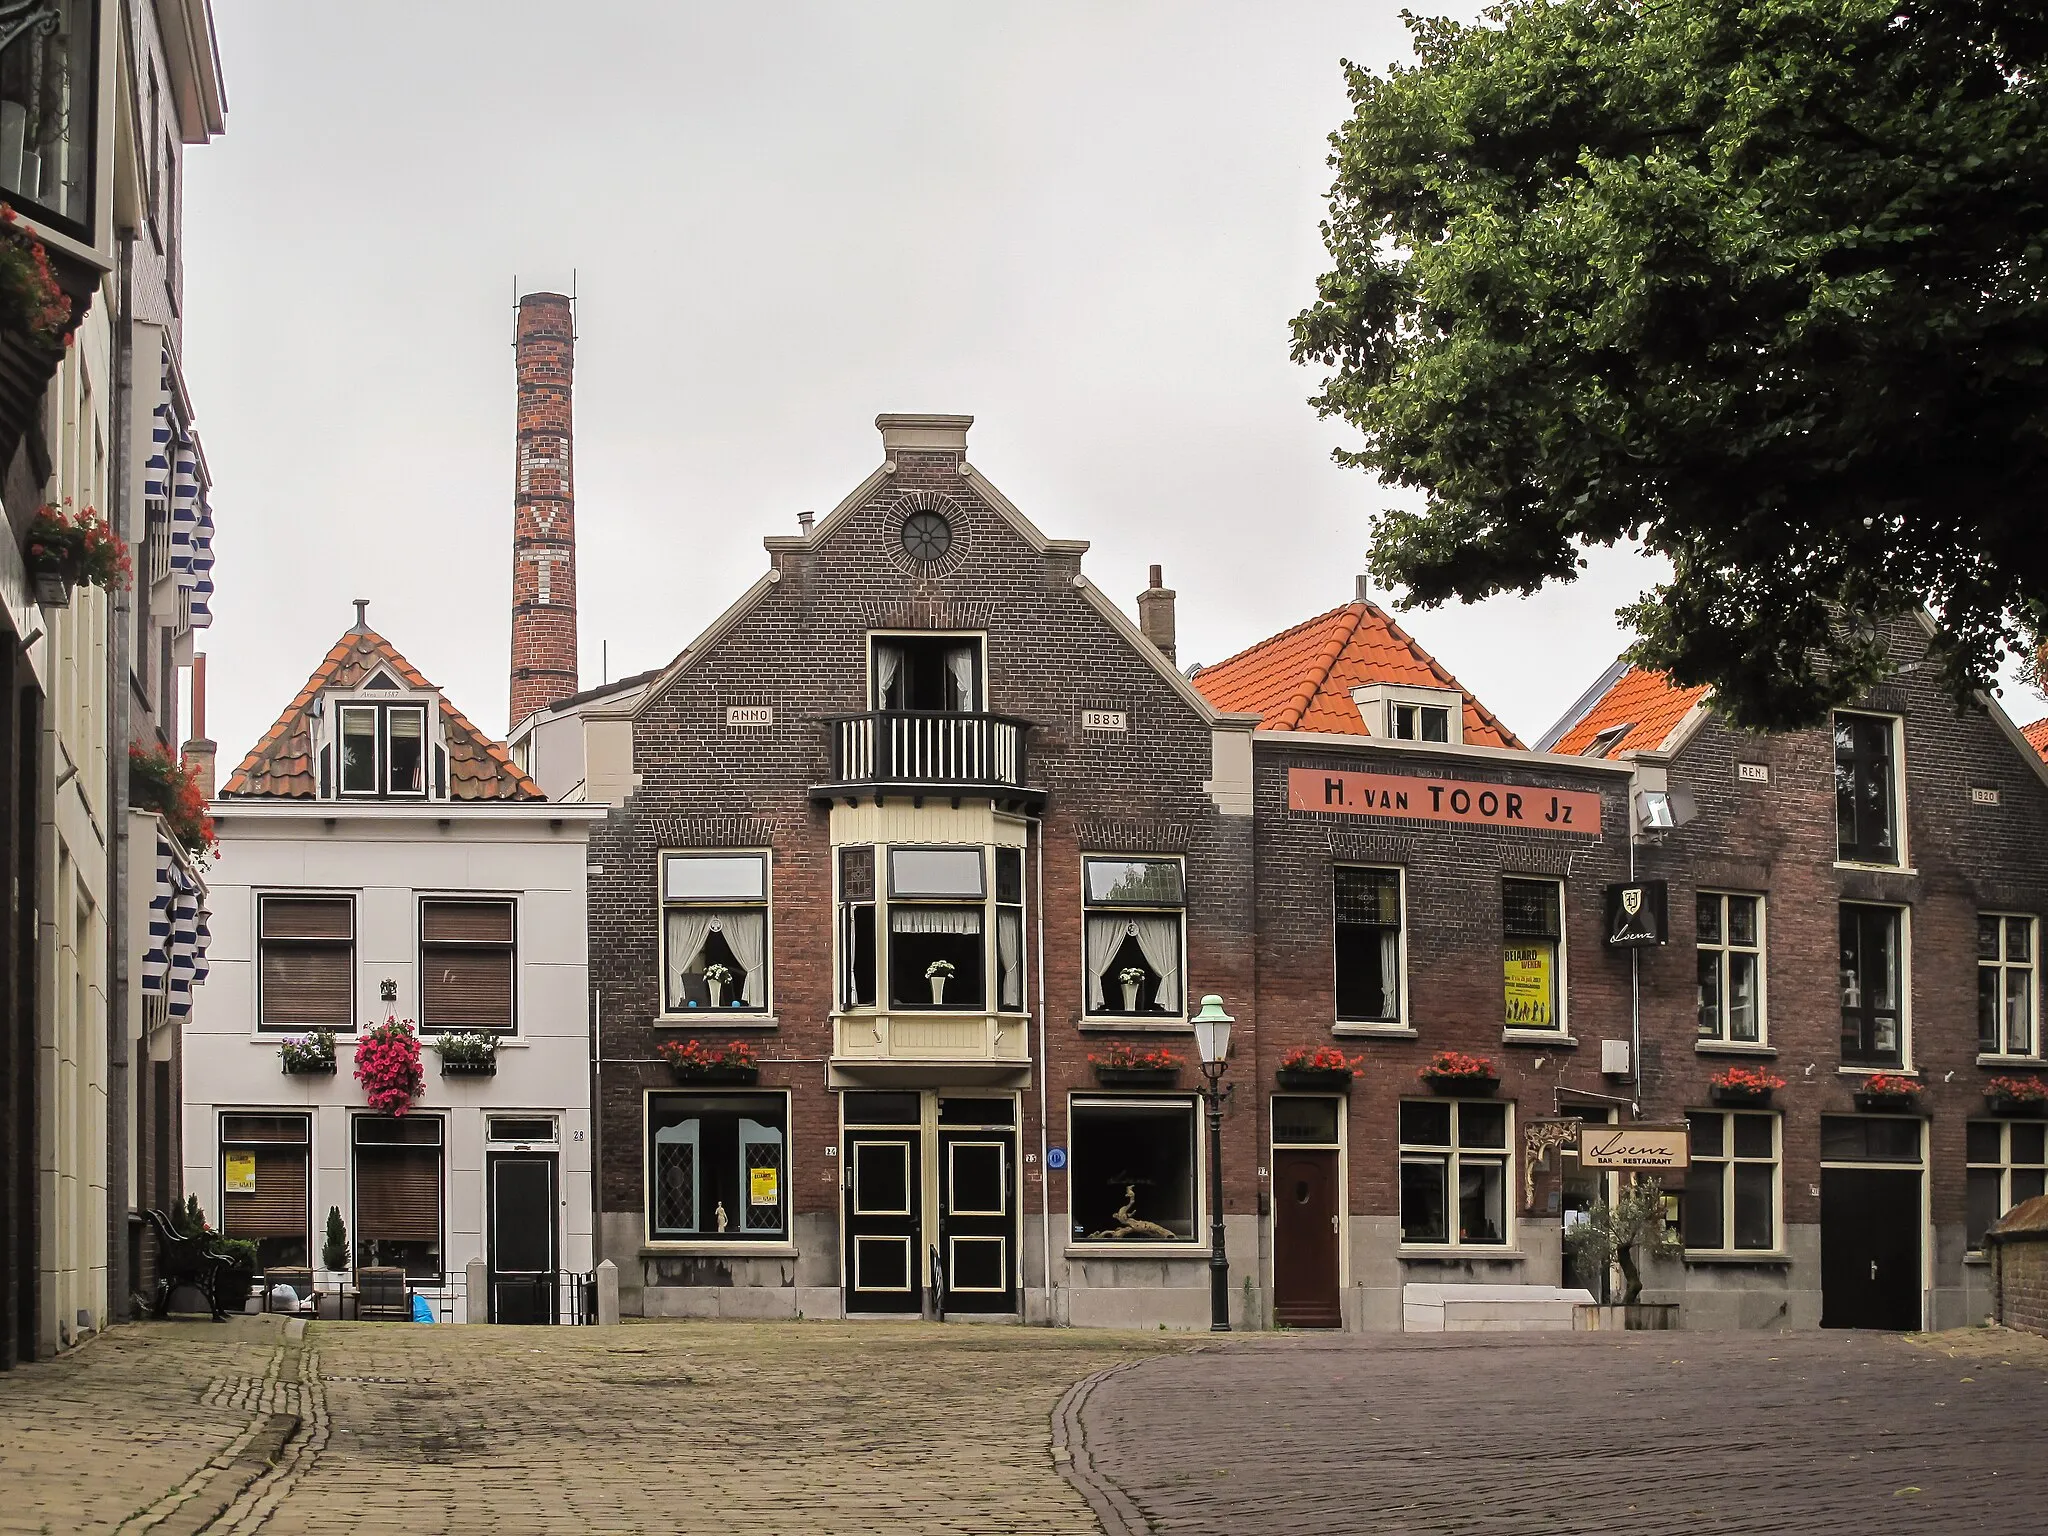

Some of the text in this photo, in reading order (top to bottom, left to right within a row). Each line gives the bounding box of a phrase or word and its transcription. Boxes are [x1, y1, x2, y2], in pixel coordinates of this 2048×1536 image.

[731, 710, 767, 721] ANNO
[1087, 713, 1120, 725] 1883
[1324, 777, 1353, 806] H.
[1364, 788, 1408, 810] VAN
[1427, 785, 1524, 820] TOOR
[1974, 790, 1995, 801] 1920
[1504, 949, 1538, 962] BEIAARD
[573, 1130, 584, 1141] 28
[1590, 1131, 1675, 1157] Loenz
